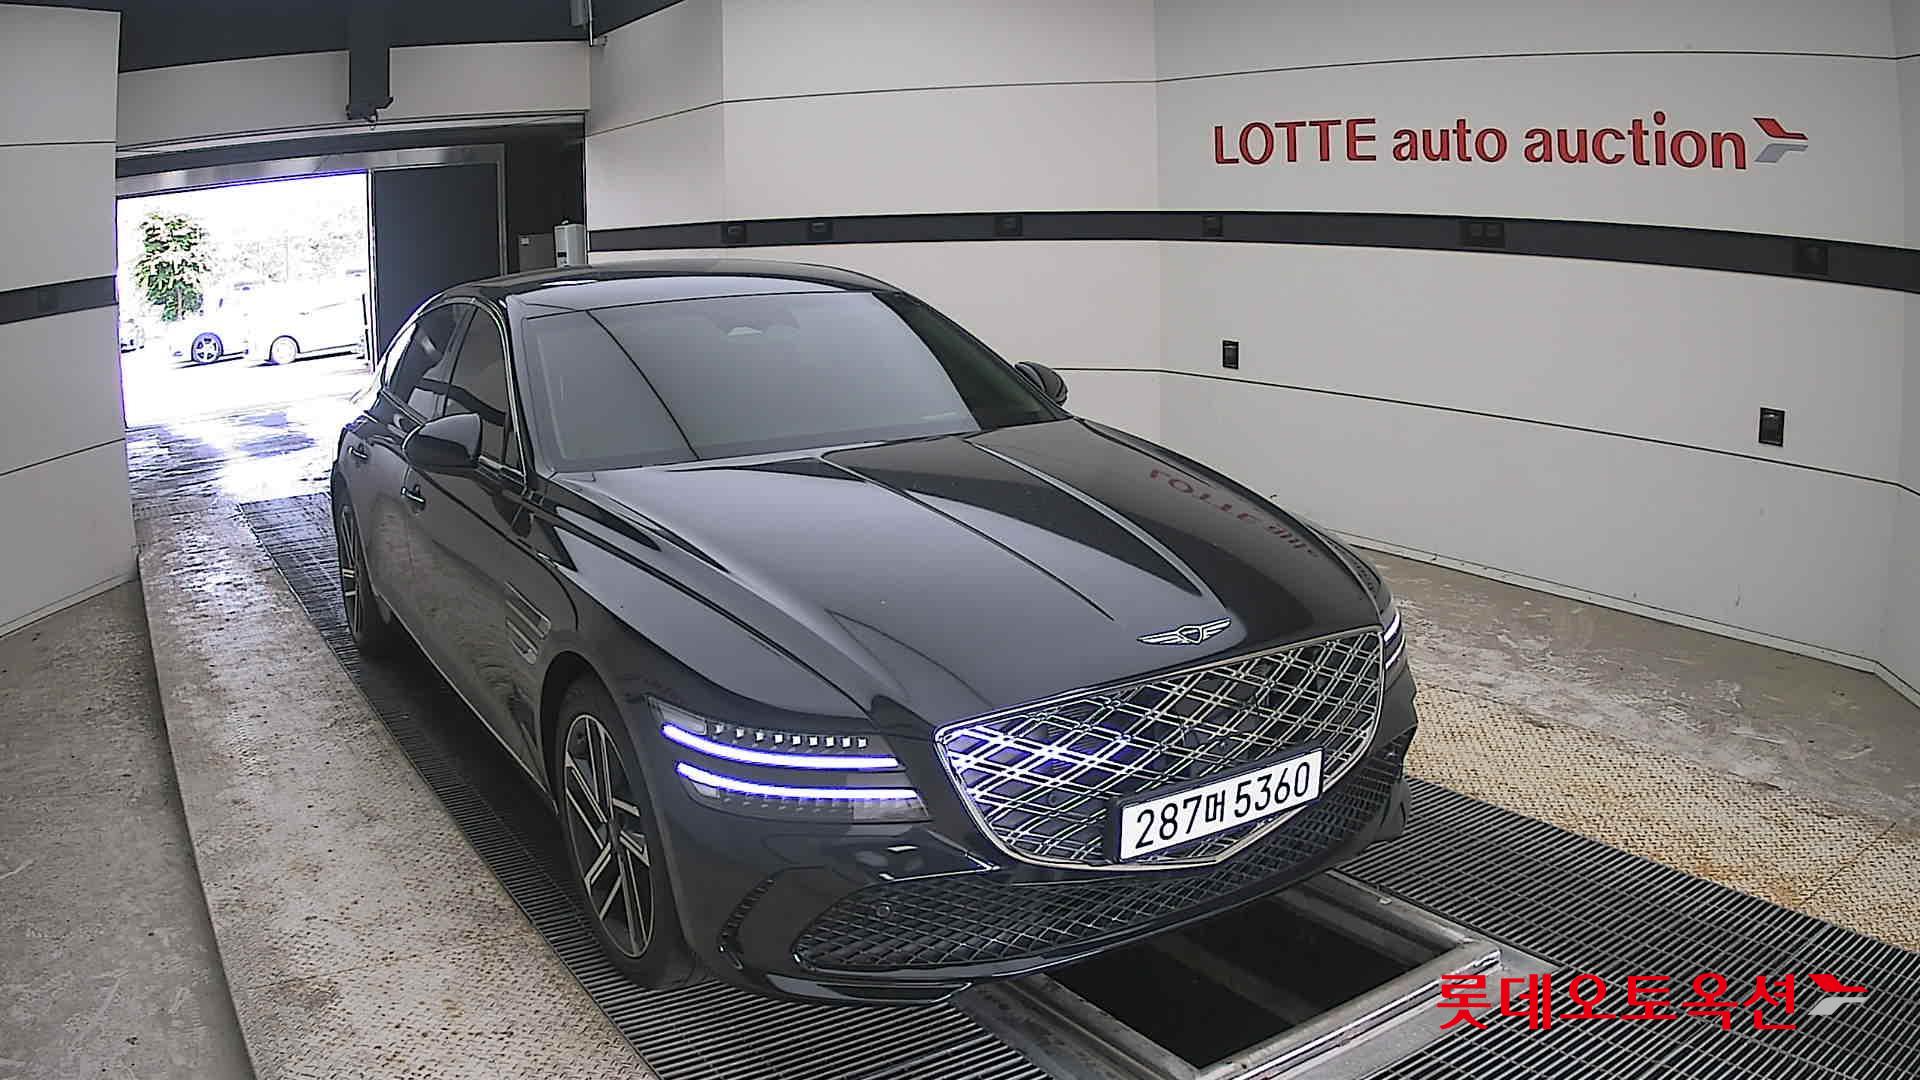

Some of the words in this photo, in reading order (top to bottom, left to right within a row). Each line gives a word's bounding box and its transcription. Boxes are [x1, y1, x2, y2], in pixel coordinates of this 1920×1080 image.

[1214, 118, 1377, 165] LOTTE
[1392, 118, 1508, 163] auto
[1523, 111, 1747, 170] auction
